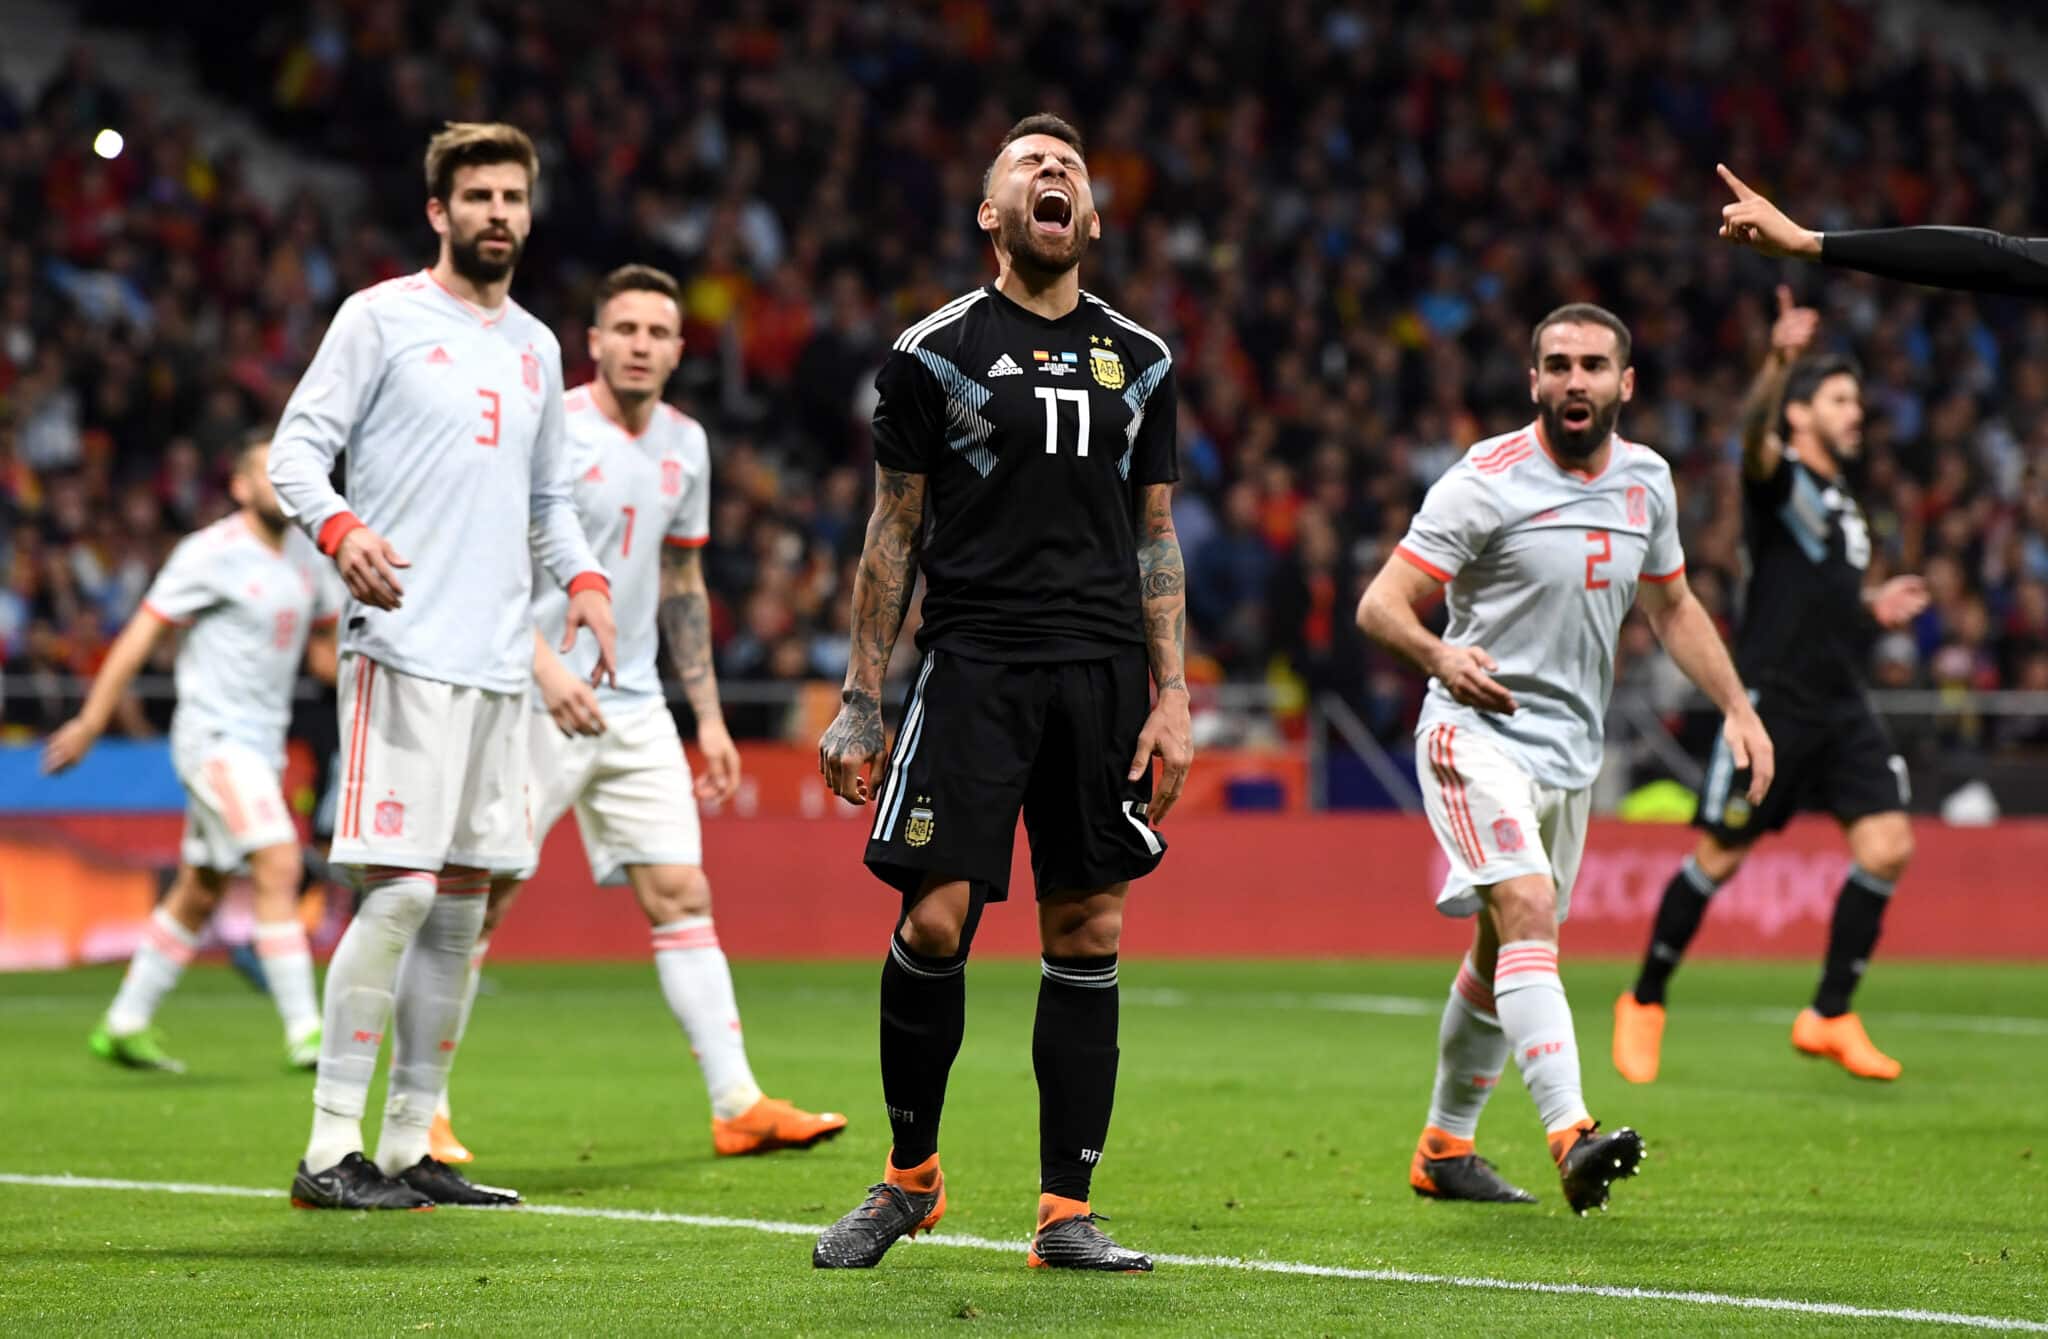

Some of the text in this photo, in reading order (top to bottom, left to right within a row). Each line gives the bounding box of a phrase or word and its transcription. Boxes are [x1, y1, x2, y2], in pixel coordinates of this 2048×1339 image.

[987, 367, 1024, 378] adidas
[475, 388, 501, 448] 3
[1034, 387, 1091, 457] 17
[1585, 531, 1612, 591] 2
